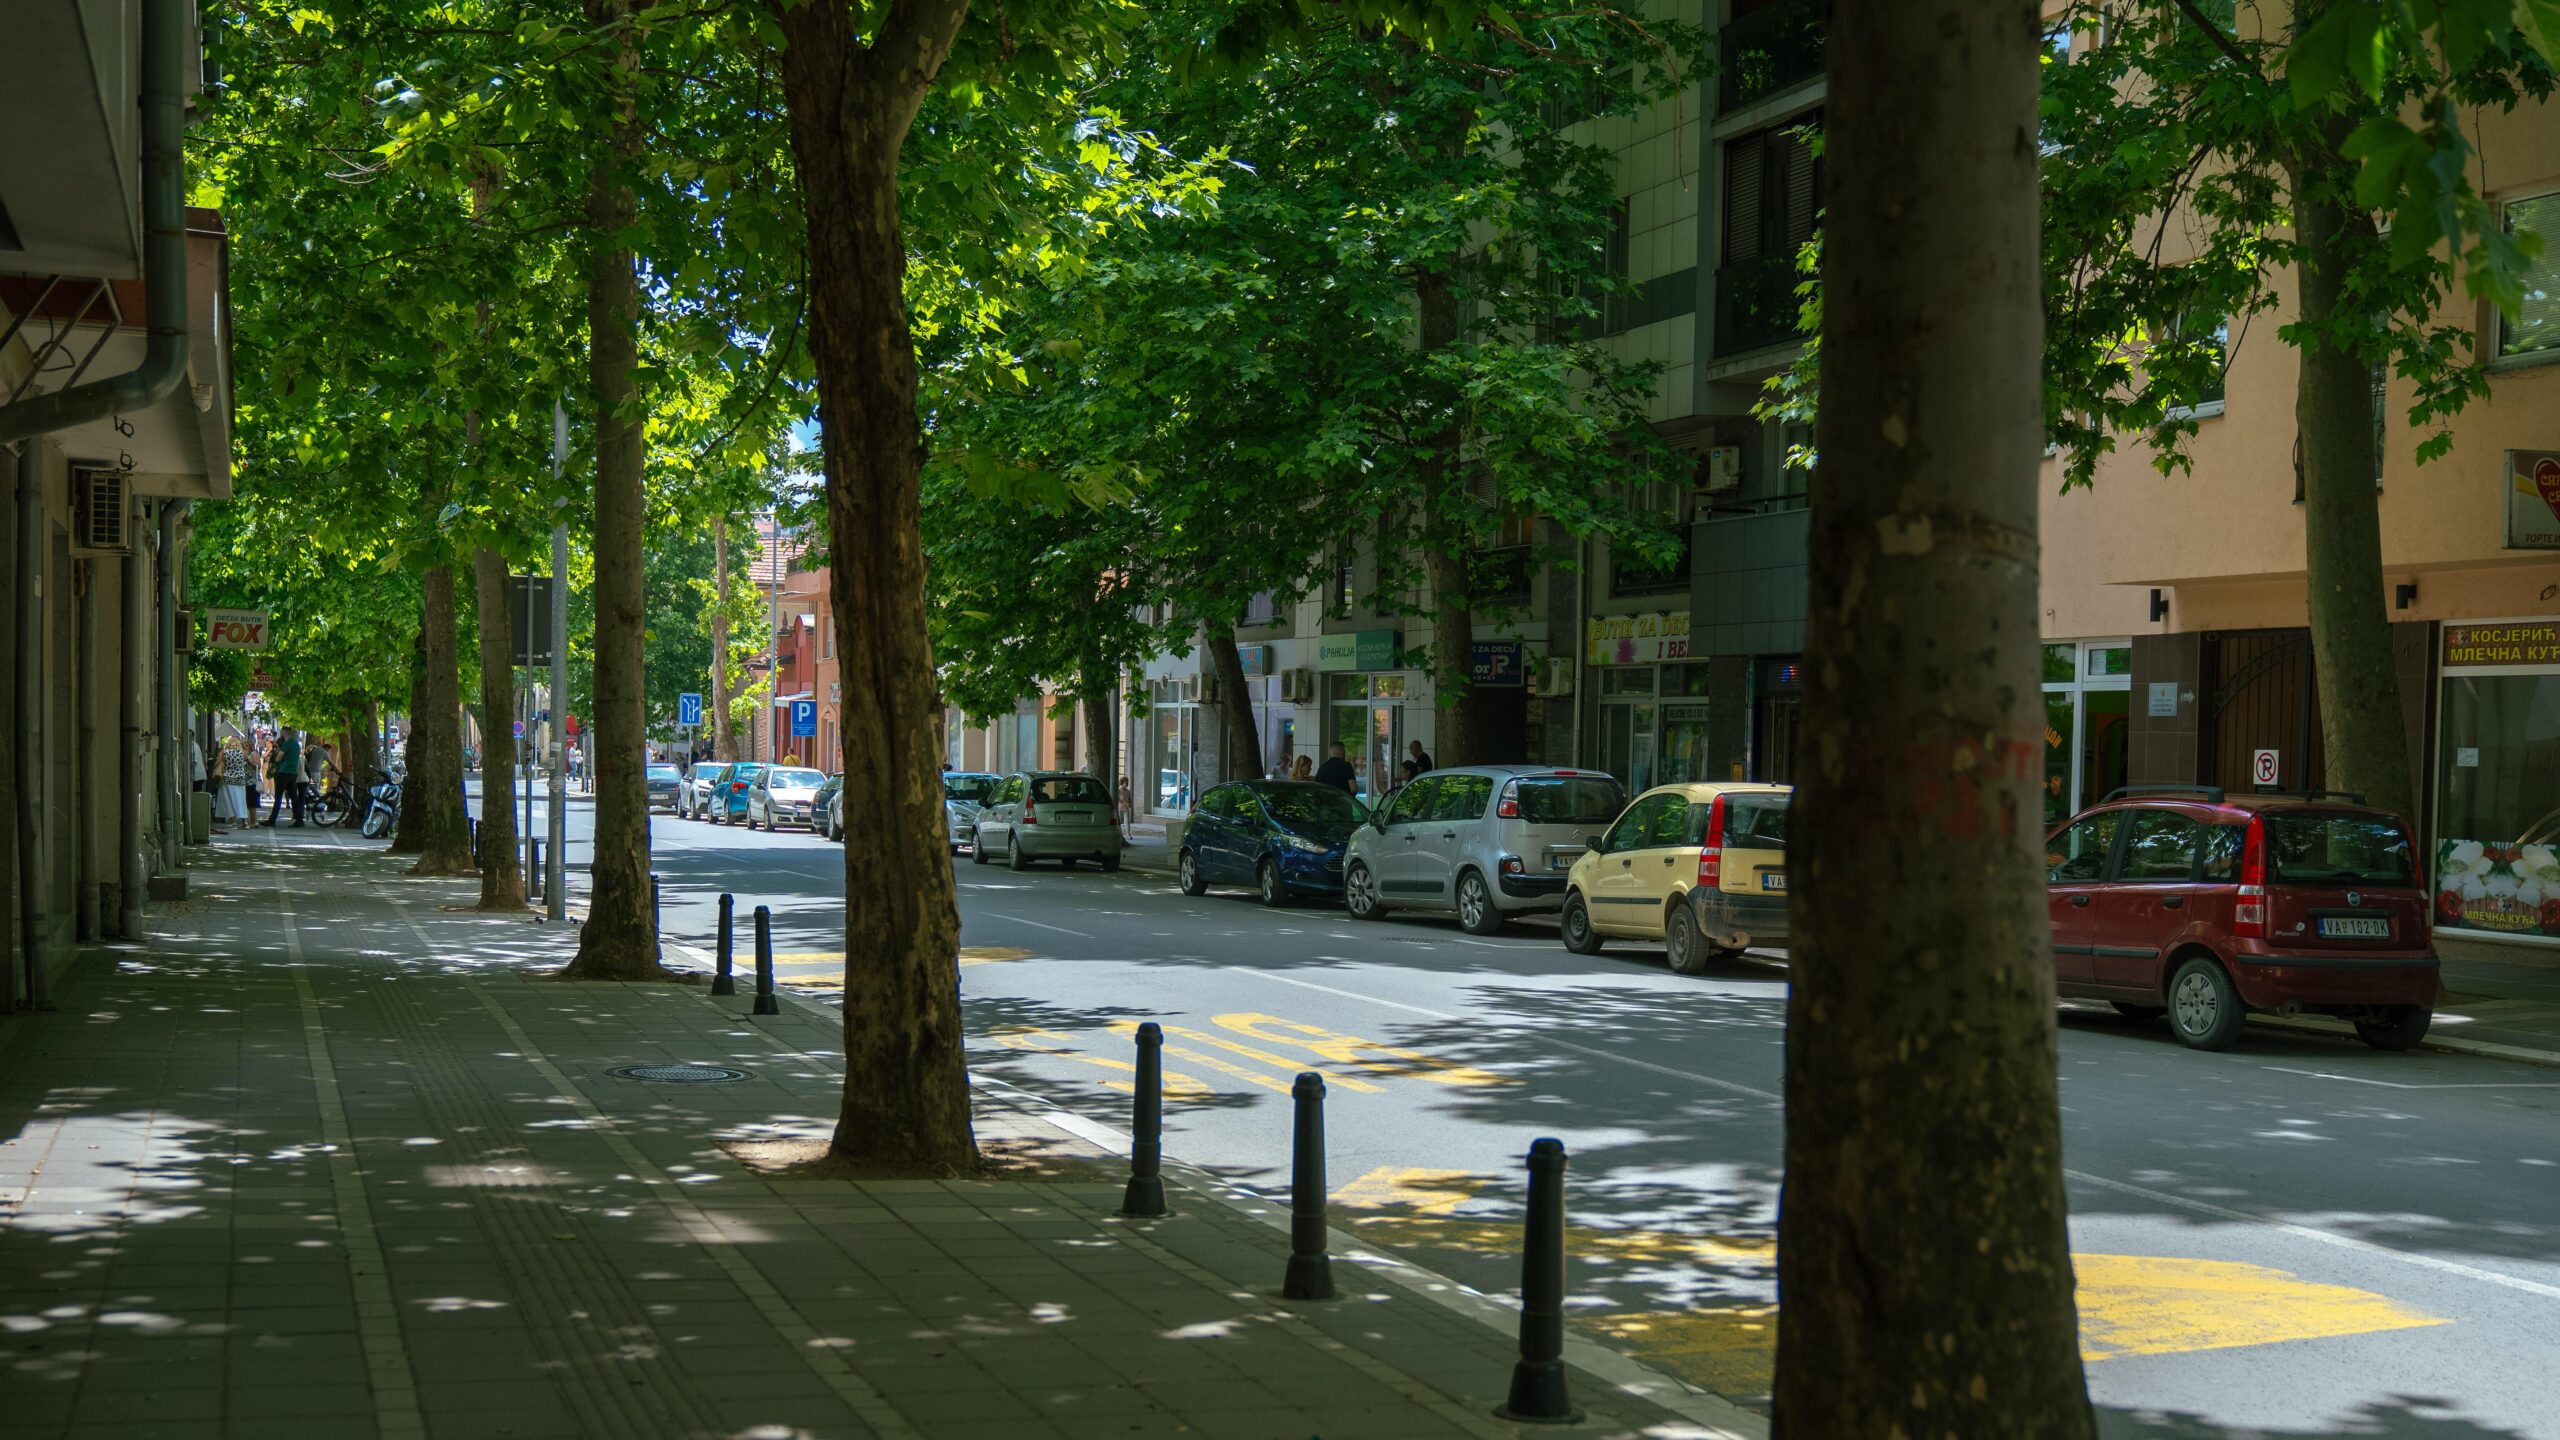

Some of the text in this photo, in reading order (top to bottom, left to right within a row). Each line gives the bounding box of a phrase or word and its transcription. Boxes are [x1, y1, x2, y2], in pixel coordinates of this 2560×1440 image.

[2526, 534, 2553, 543] ТОРТЕ
[211, 622, 263, 644] FOX
[1594, 620, 1634, 640] BUTIK
[1638, 617, 1657, 638] ZA
[2471, 628, 2556, 643] КОСЈЕРИЋ
[1326, 646, 1355, 658] PAHULJA
[1478, 645, 1490, 653] ZA
[1491, 645, 1516, 653] DECU
[1658, 641, 1664, 659] I
[2450, 646, 2522, 662] МЛЕЧНА
[798, 703, 811, 722] P
[1770, 876, 1783, 887] VA
[2464, 910, 2536, 925] МЛЕЧНА КУЋА
[2326, 919, 2341, 934] VA
